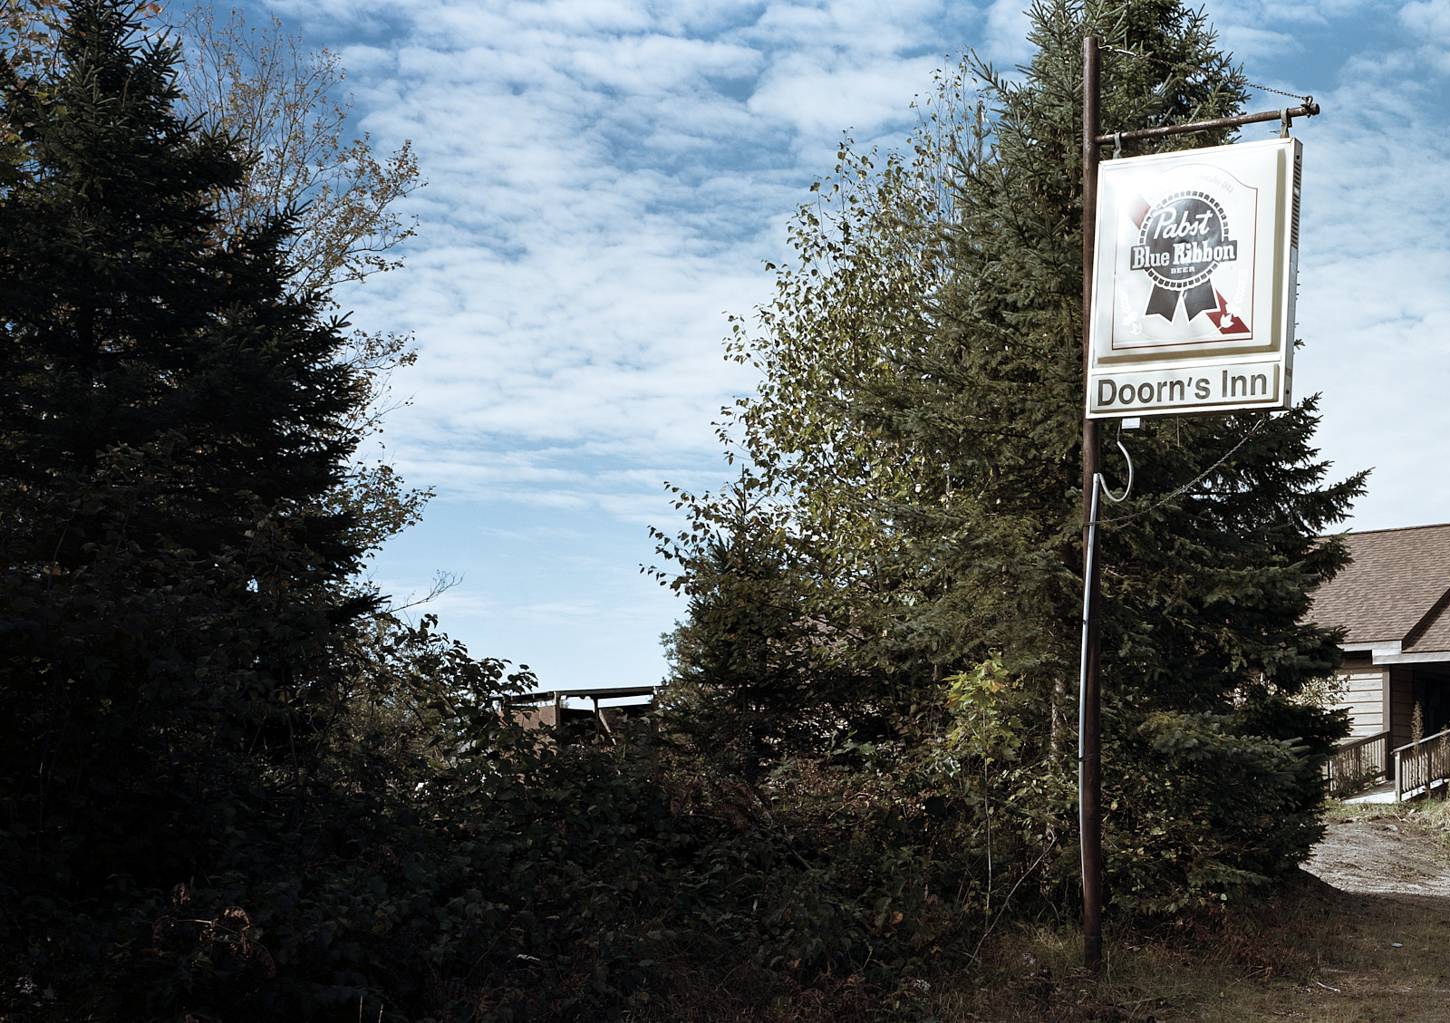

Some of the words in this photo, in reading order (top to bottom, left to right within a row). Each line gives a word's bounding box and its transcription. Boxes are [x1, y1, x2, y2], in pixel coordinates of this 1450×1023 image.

[1151, 207, 1213, 240] Pabst
[1132, 246, 1170, 269] Blue
[1173, 240, 1235, 265] Ribbon
[1170, 266, 1195, 274] BEER
[1097, 377, 1211, 407] Doorn's
[1222, 370, 1267, 398] Inn
